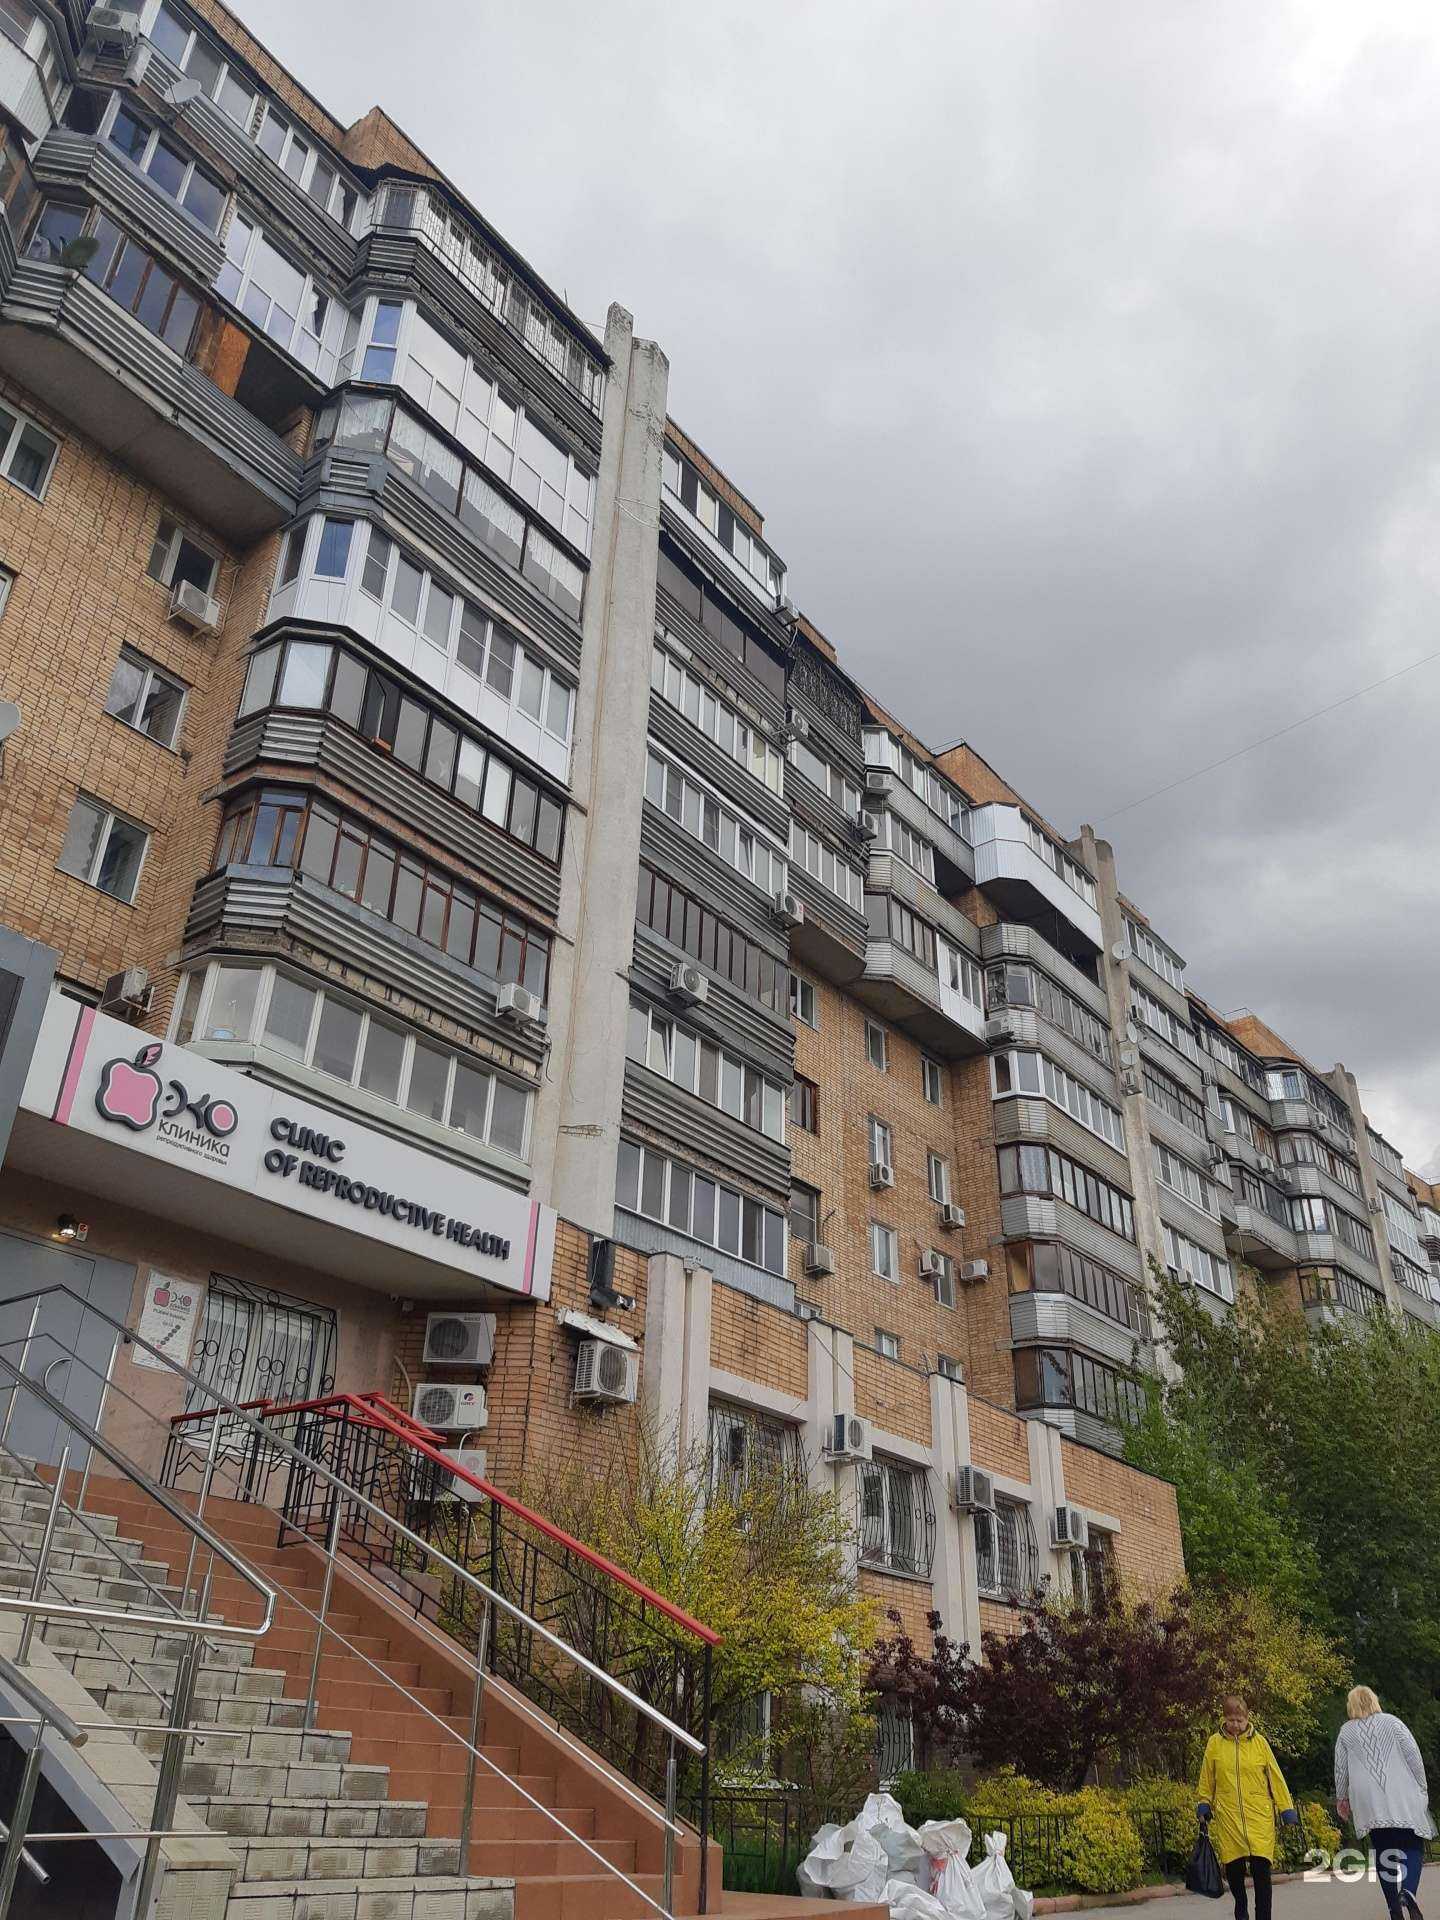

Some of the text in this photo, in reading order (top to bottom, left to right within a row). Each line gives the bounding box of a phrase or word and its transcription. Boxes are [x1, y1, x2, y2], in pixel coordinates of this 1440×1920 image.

[270, 1117, 346, 1163] CLINIC
[264, 1149, 511, 1260] OF REPRODUCTIVE HEALTH
